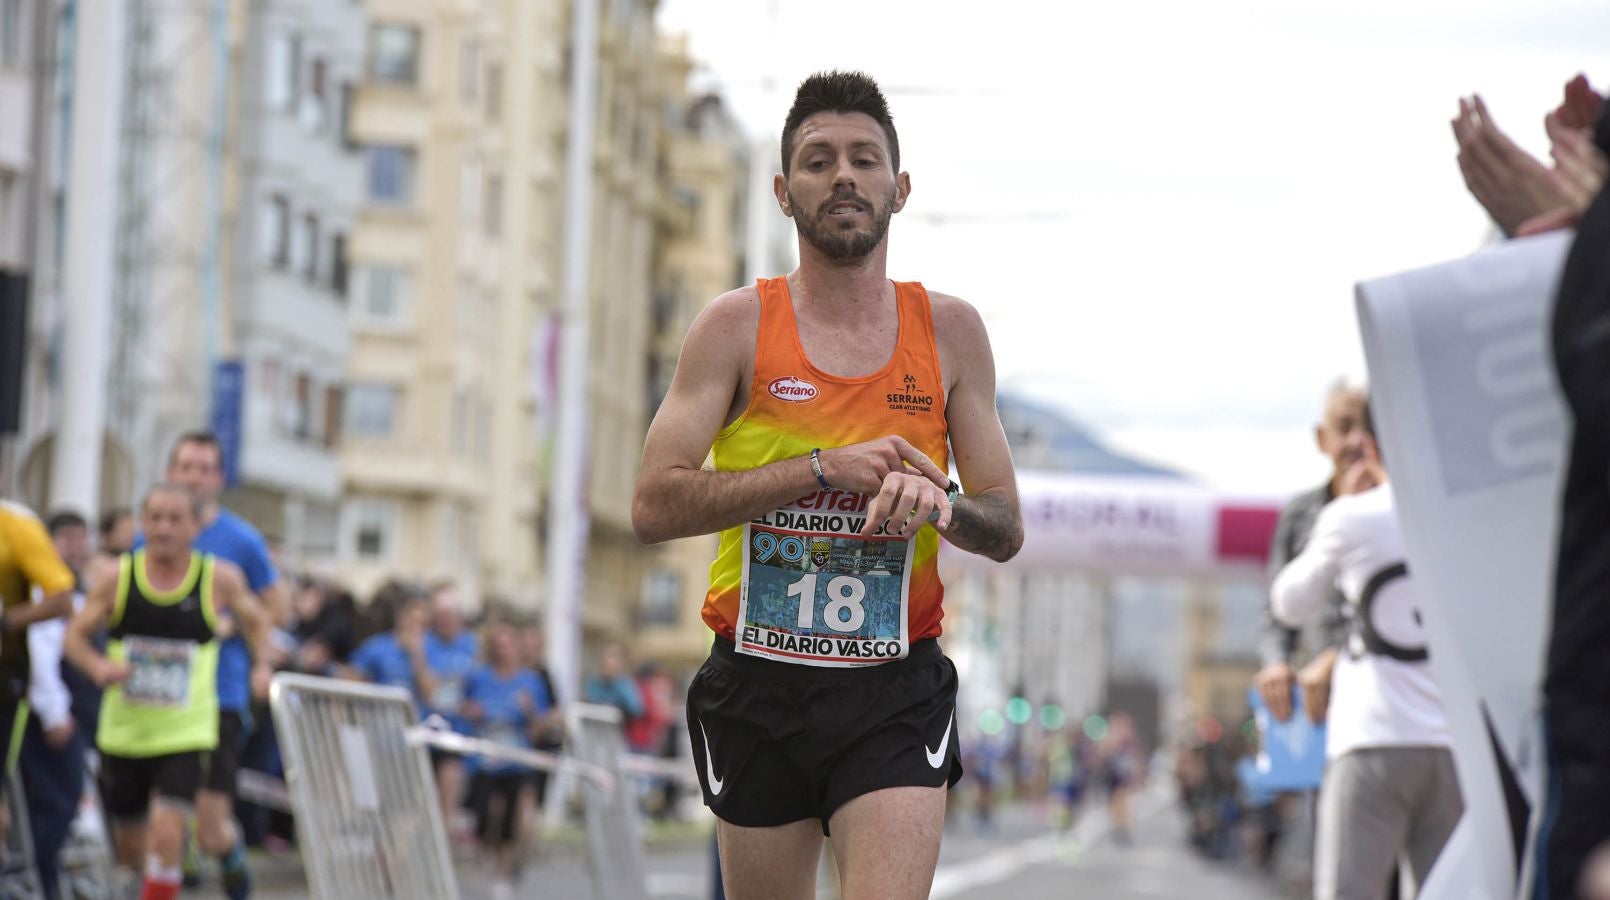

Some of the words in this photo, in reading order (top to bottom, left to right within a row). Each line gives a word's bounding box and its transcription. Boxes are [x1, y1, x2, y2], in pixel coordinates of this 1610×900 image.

[773, 382, 815, 397] Serrano
[886, 393, 933, 405] SERRANO
[775, 512, 843, 532] DIARIO
[753, 531, 806, 564] 90
[786, 573, 867, 633] 18
[742, 627, 764, 646] EL
[766, 631, 834, 656] DIARIO
[835, 639, 902, 658] VASCO
